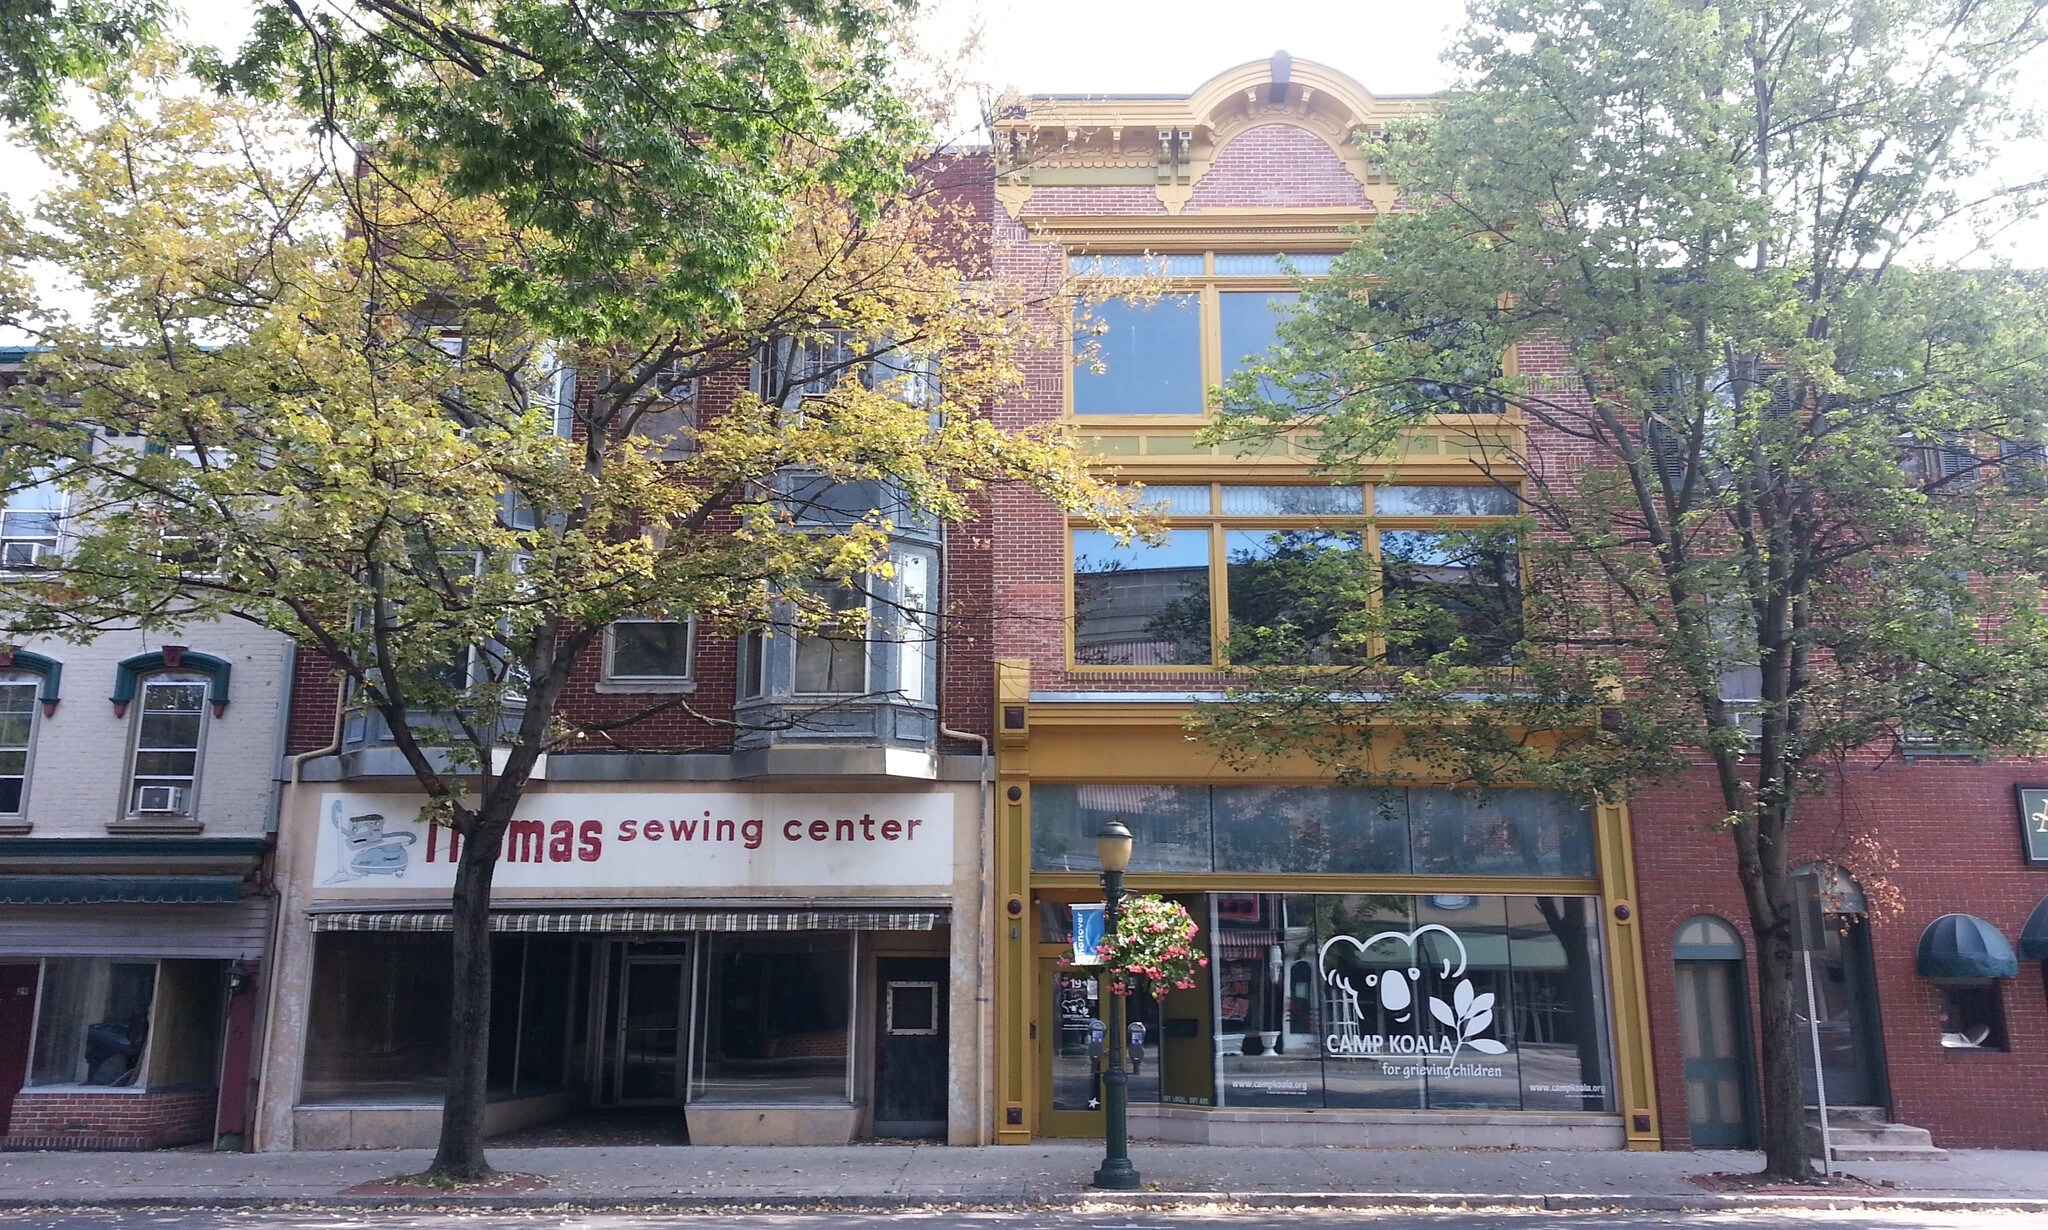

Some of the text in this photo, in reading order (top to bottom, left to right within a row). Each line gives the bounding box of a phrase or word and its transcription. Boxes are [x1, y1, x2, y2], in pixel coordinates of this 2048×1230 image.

[426, 810, 922, 863] Tmas sewing center
[1076, 912, 1085, 955] hanover
[1326, 1034, 1453, 1054] CAMP KOALA
[1382, 1062, 1502, 1079] for grieving children
[1232, 1080, 1307, 1091] www.campkoala.org
[1529, 1083, 1605, 1094] www.campkoala.org
